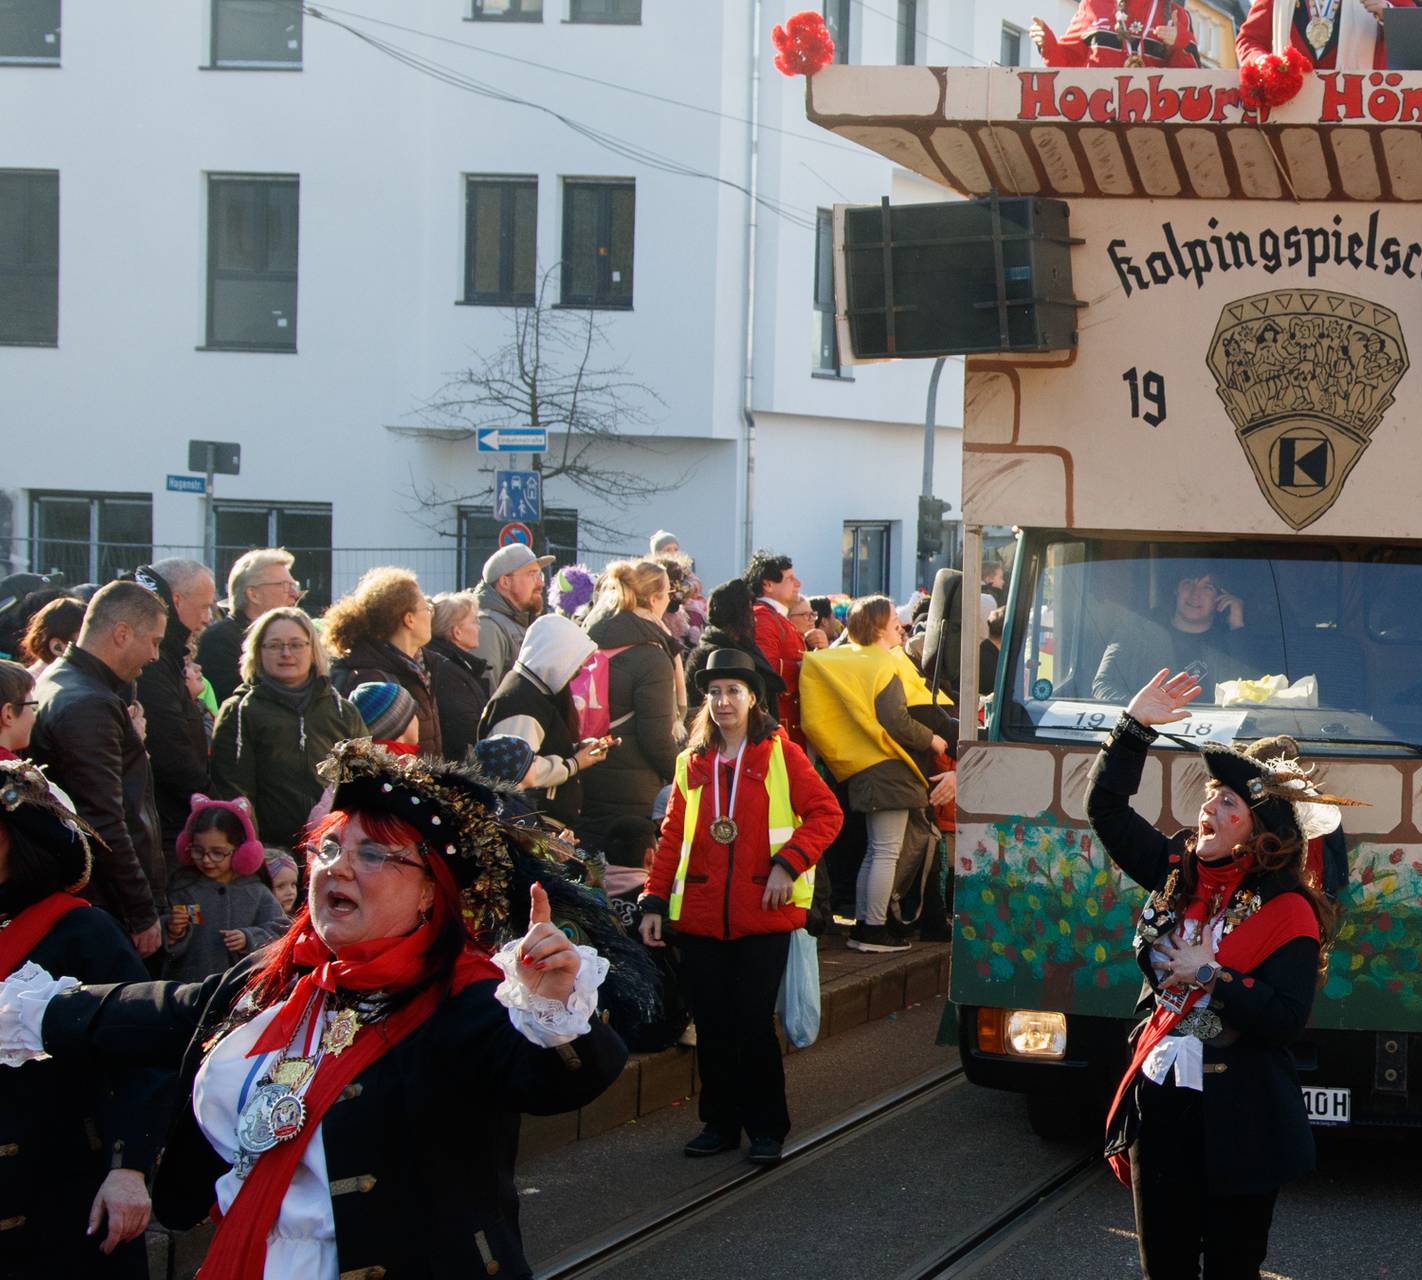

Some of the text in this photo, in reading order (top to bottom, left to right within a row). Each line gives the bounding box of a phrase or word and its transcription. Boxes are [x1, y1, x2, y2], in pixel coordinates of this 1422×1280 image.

[1122, 366, 1167, 428] 19
[168, 477, 203, 490] Hagenstr.
[1075, 711, 1106, 728] 19
[1181, 721, 1212, 736] 18
